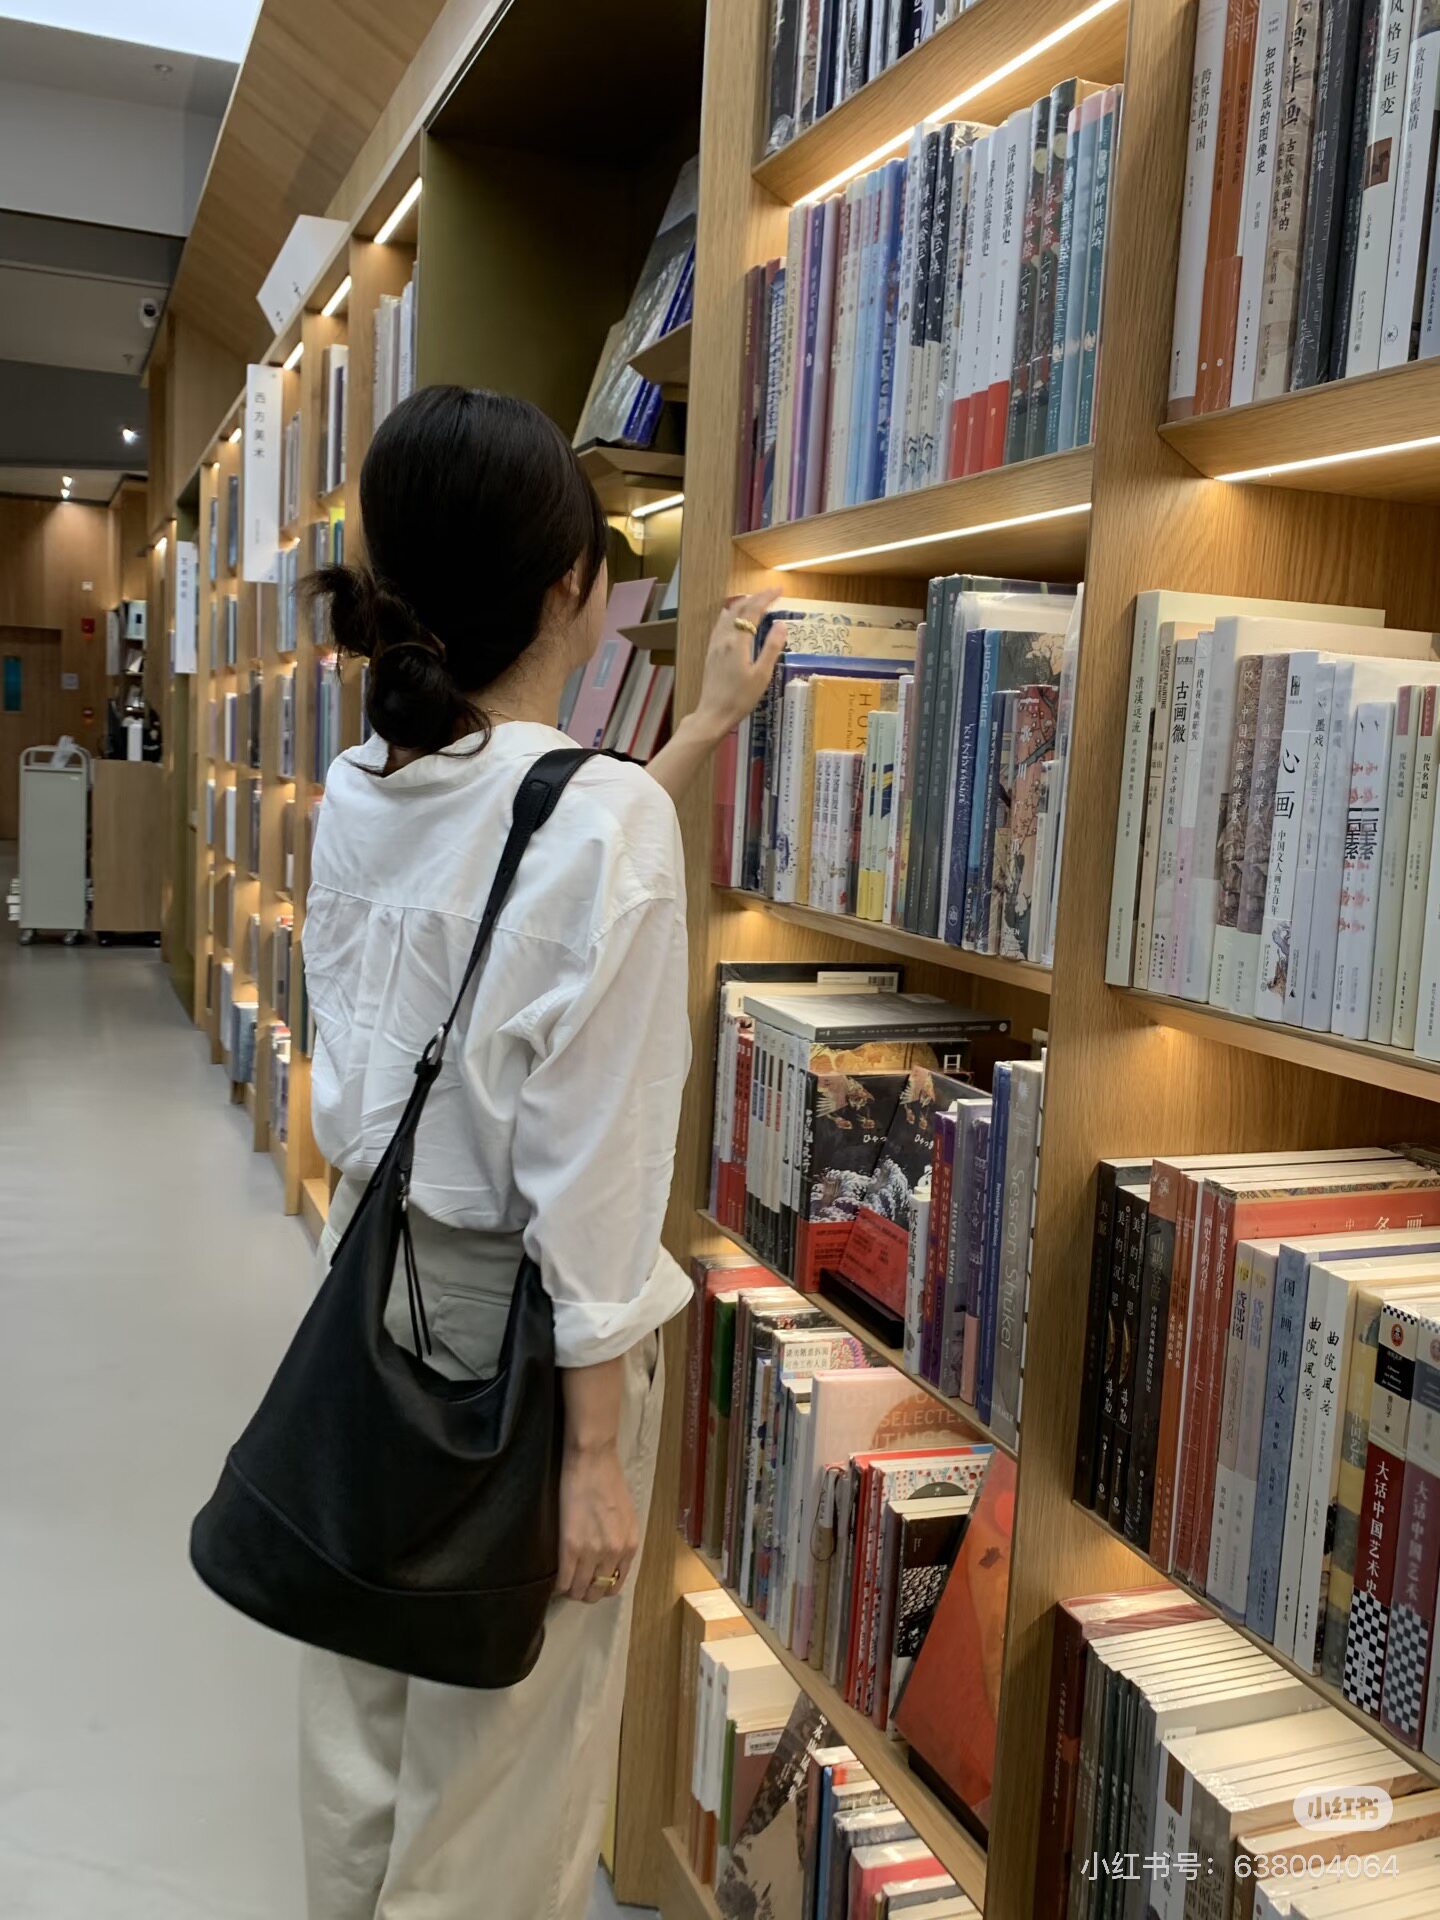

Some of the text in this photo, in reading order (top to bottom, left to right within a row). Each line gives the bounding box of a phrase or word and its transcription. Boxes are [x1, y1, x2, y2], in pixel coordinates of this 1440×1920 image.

[1380, 0, 1404, 119] 风格与世变
[1196, 67, 1212, 152] 跨界的中国
[1255, 47, 1277, 176] 知识生成的图像史
[1279, 138, 1297, 231] 古代绘画中的
[1131, 675, 1145, 733] 清溪远流
[1172, 680, 1190, 744] 古画微
[1313, 718, 1325, 747] 墨戏
[1275, 748, 1300, 819] 心画
[1421, 753, 1431, 800] 历代名画记
[948, 1202, 959, 1285] SILVER WIND
[1005, 1169, 1026, 1257] Sesson
[1111, 1209, 1125, 1308] 美的沉思
[1126, 1217, 1141, 1316] 美的沉思
[1272, 1277, 1296, 1405] 国画讲义
[879, 1408, 966, 1428] SELECTE
[1365, 1461, 1390, 1601] 大话中国艺术史
